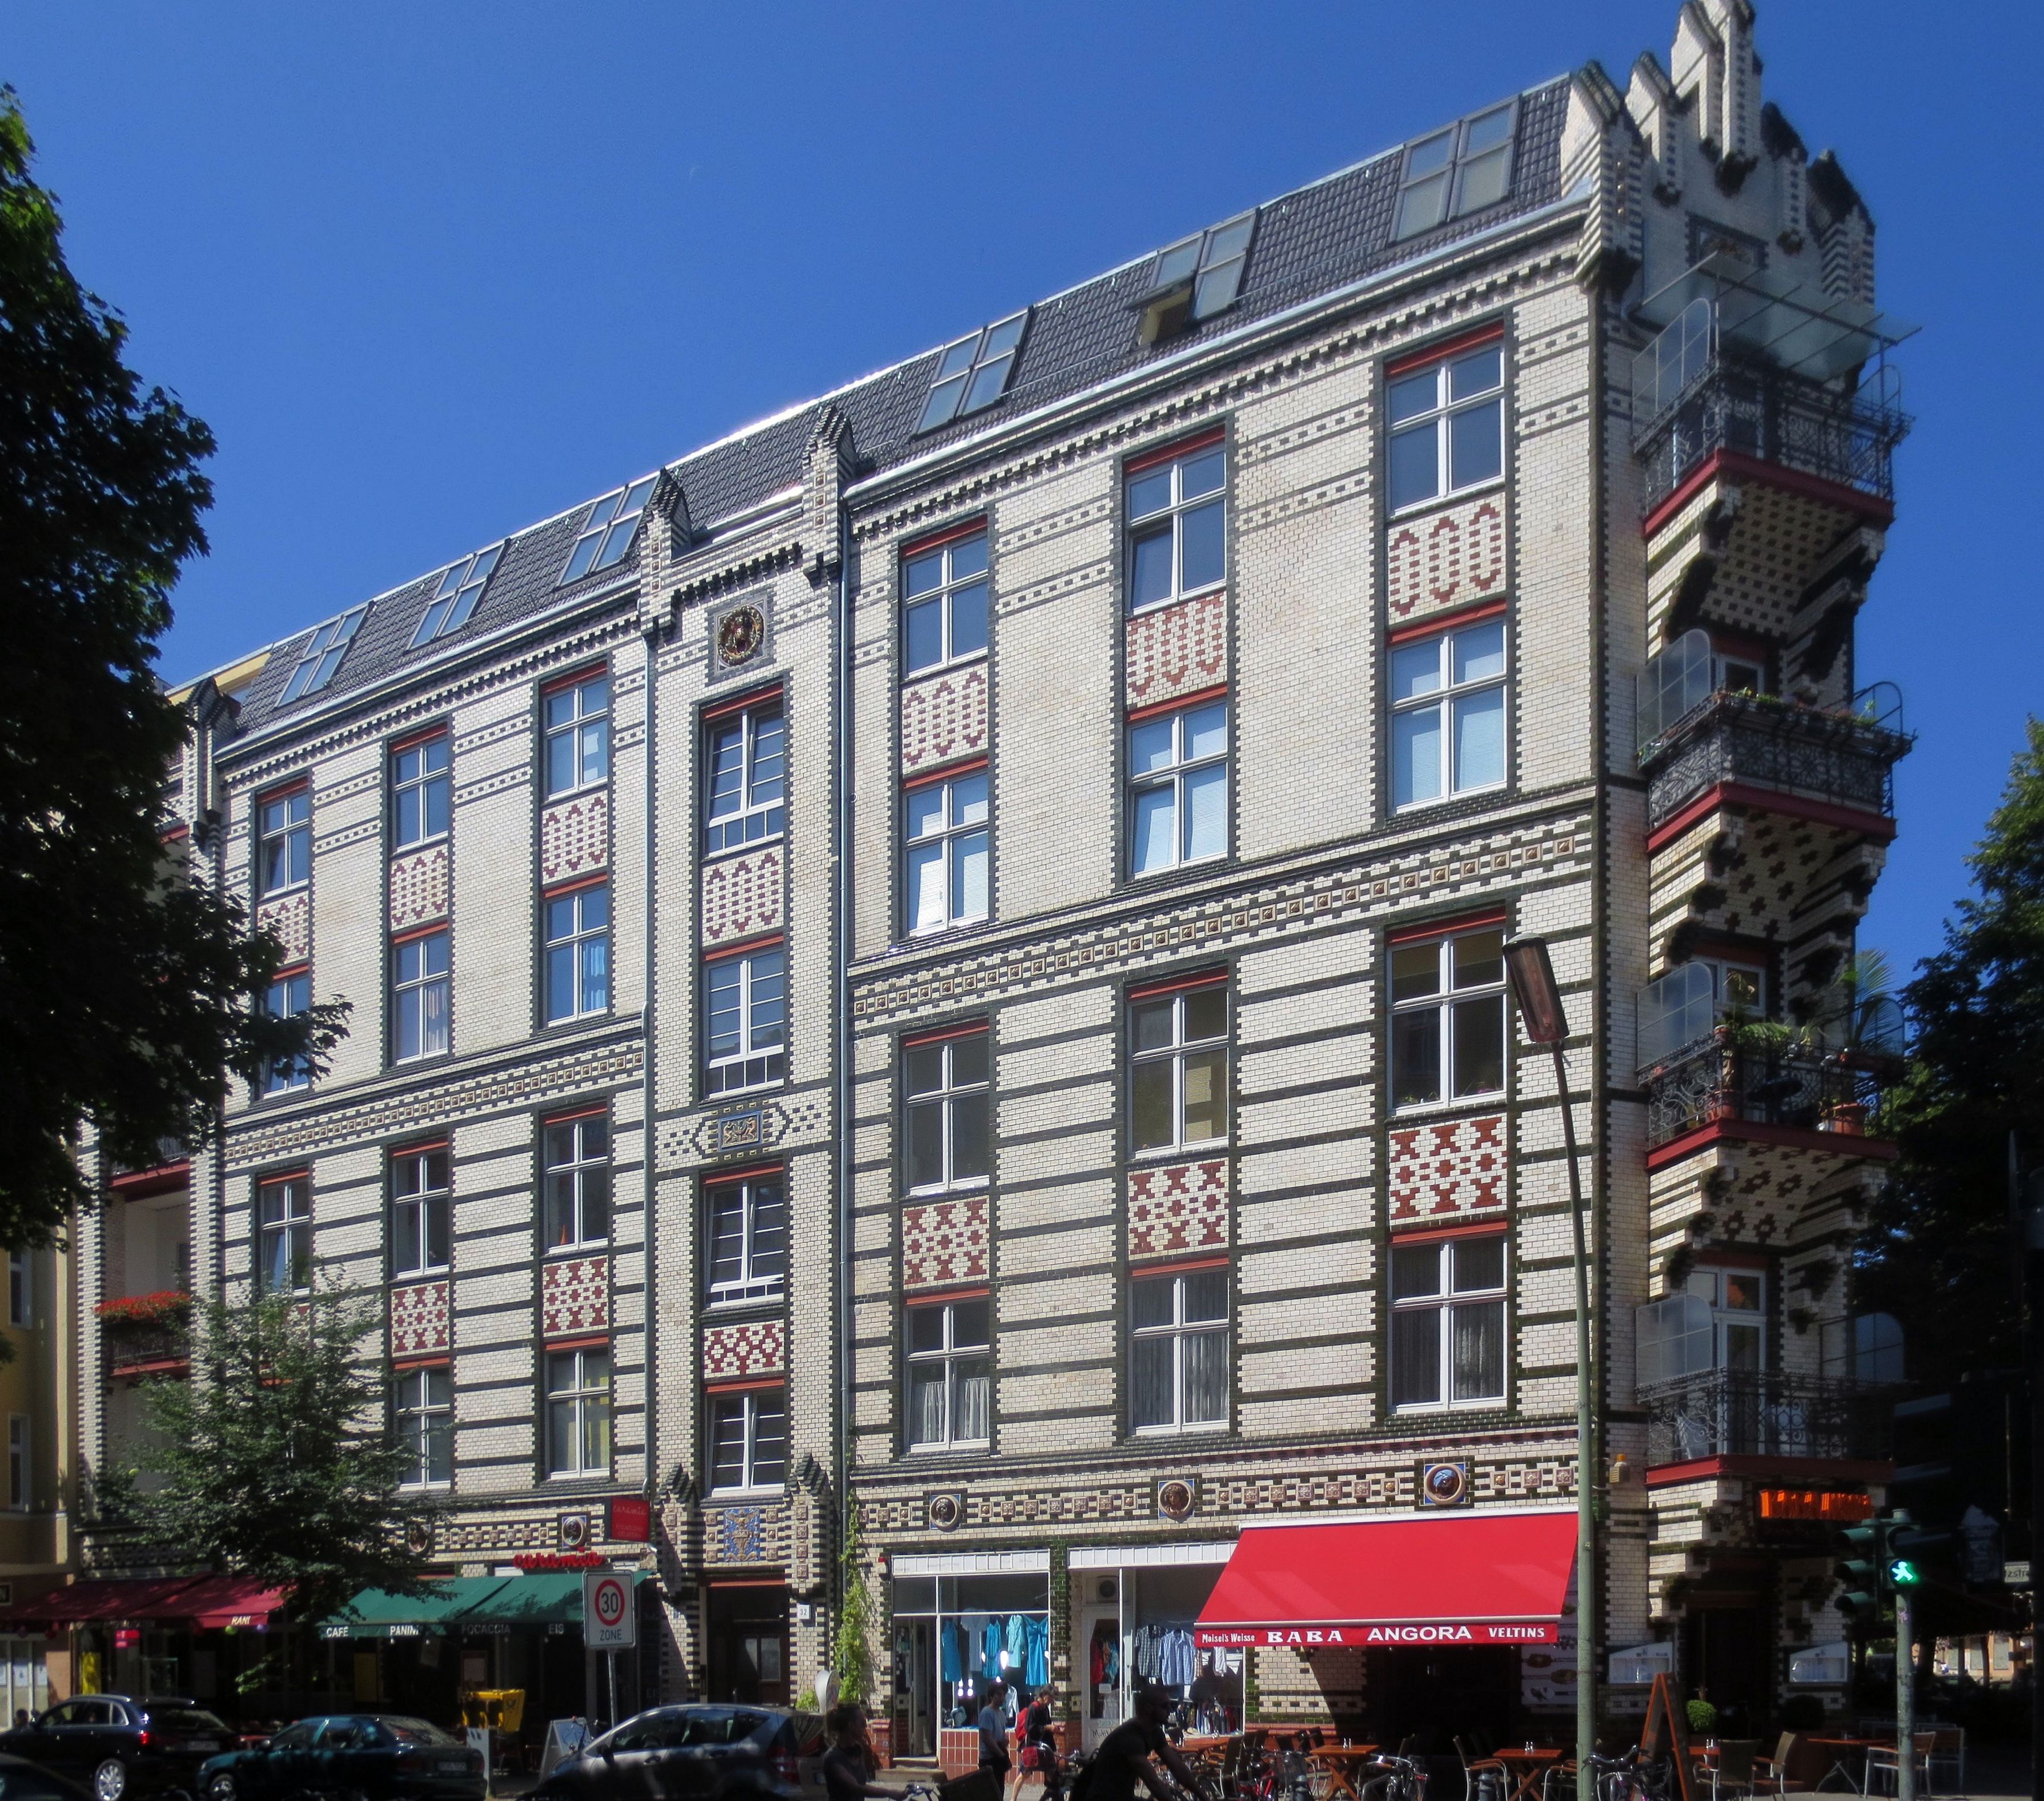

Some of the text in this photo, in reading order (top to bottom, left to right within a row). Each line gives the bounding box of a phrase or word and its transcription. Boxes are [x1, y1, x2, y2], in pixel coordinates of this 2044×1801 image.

[601, 1592, 619, 1614] 30
[461, 1624, 511, 1635] FOCACCIA
[548, 1623, 564, 1635] EIS
[600, 1629, 622, 1641] ZONE
[1202, 1626, 1545, 1643] Maisel's Weisse BABA ANGORA VELTINS
